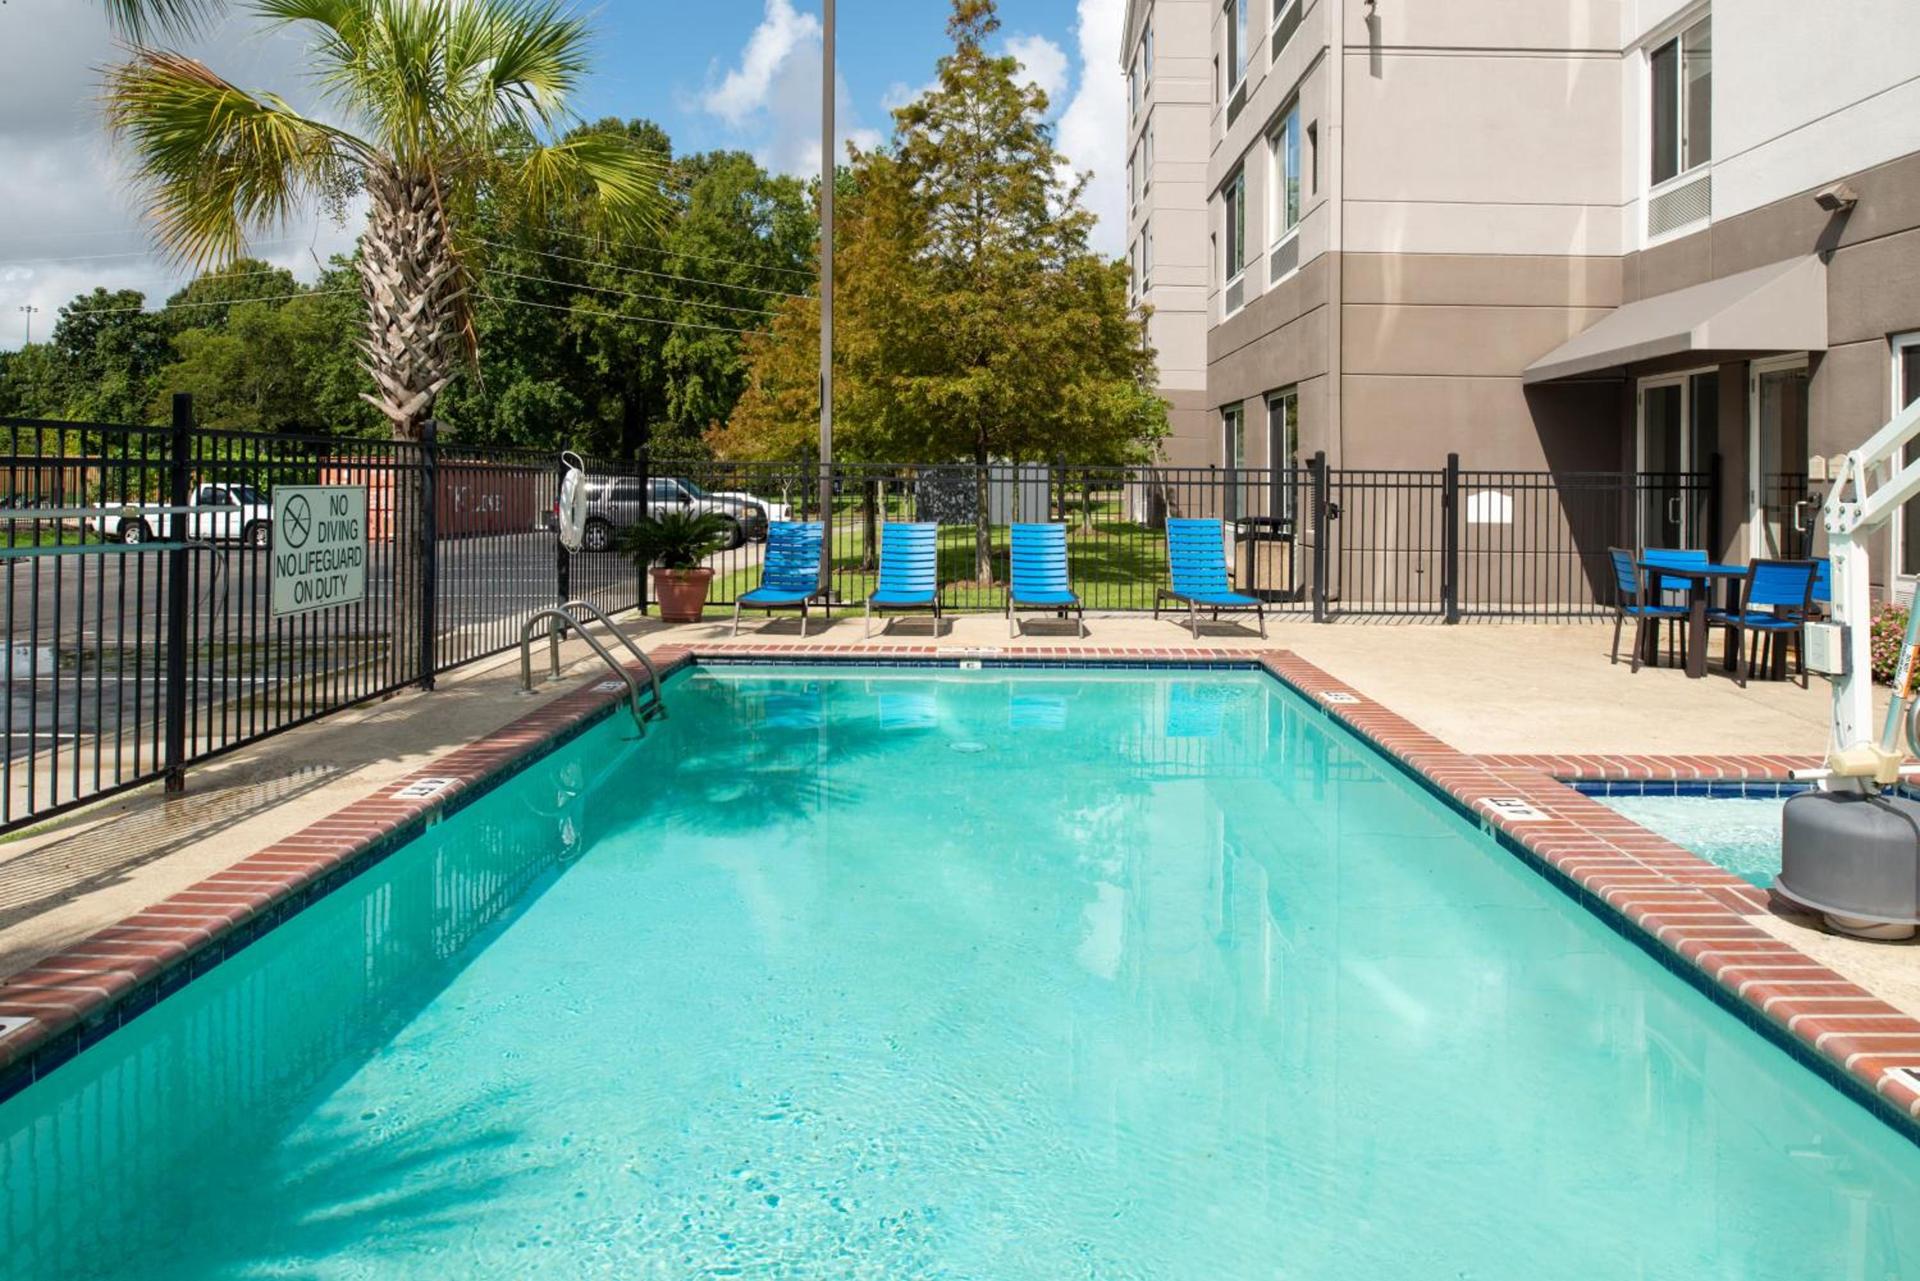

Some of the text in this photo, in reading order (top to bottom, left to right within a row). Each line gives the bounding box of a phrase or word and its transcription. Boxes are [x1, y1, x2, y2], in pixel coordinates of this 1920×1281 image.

[330, 494, 348, 516] NO
[318, 519, 358, 543] DIVING
[276, 546, 362, 578] NO LIFEGUARD
[294, 574, 348, 604] ON DUTY
